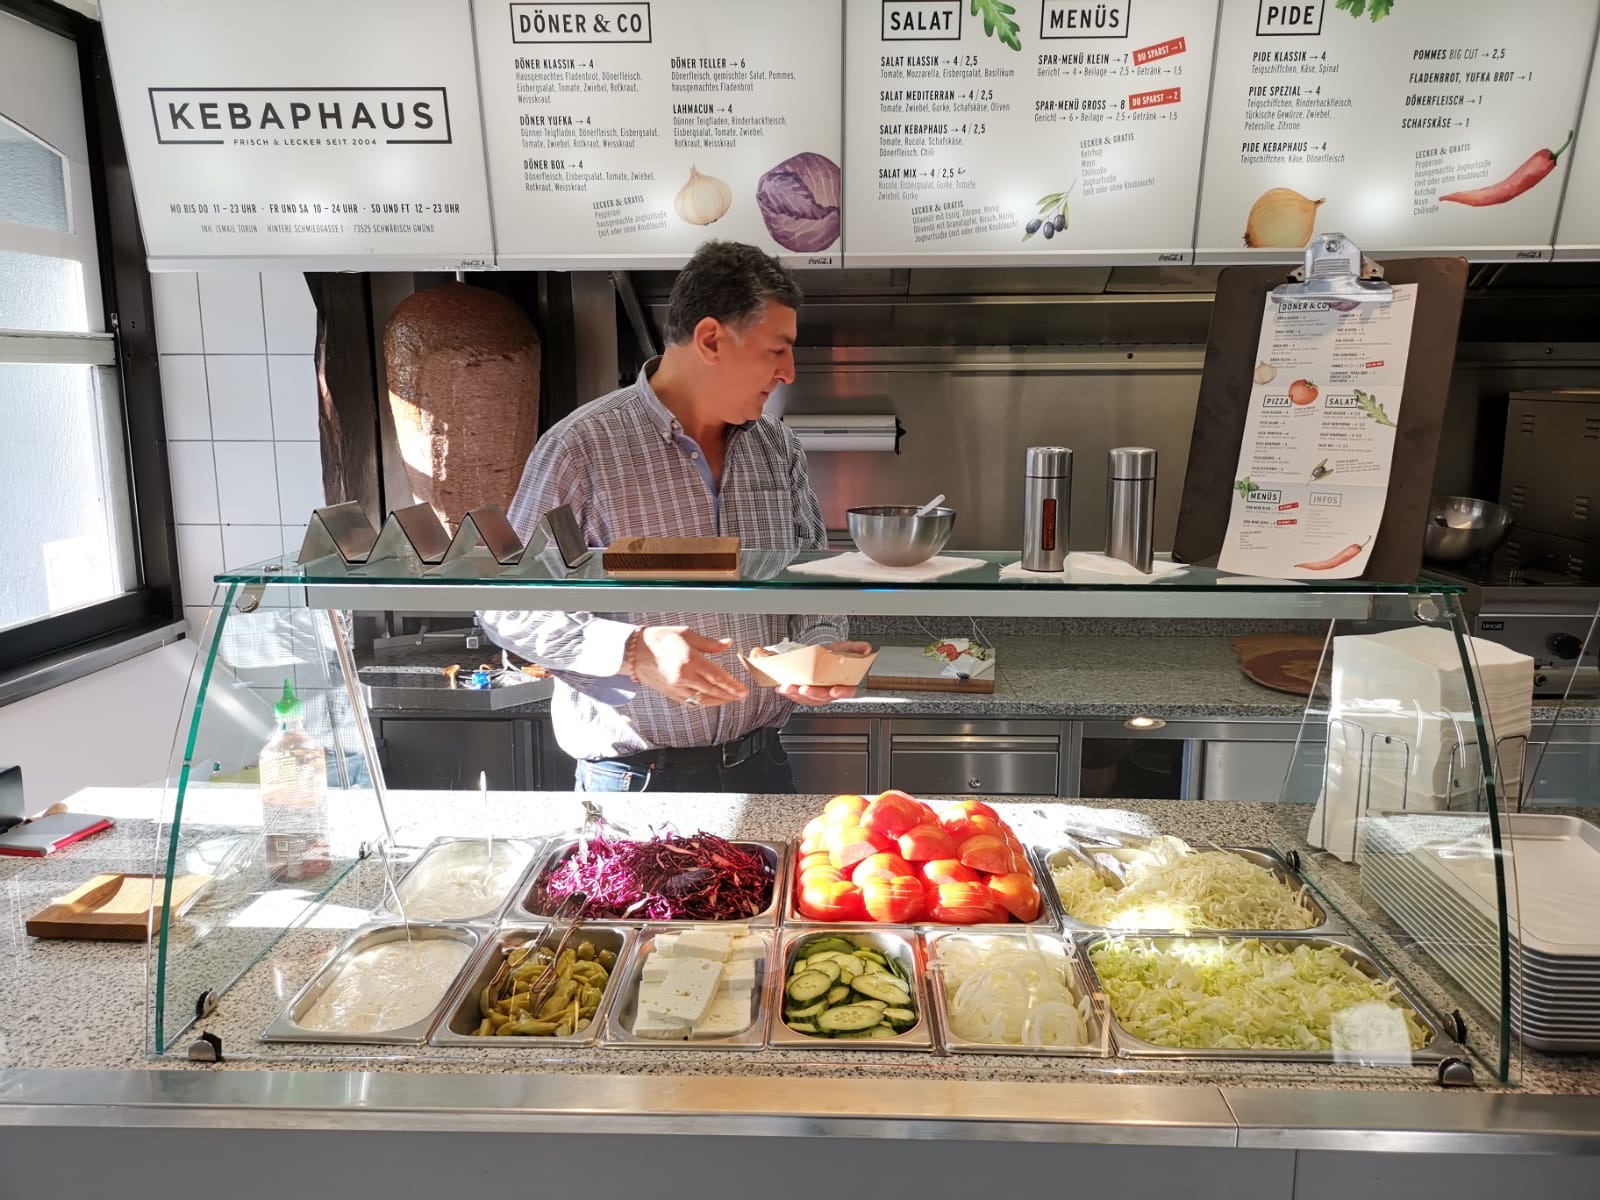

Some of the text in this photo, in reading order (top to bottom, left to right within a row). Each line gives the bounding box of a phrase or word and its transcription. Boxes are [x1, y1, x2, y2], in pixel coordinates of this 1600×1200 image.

[890, 11, 952, 31] SALAT
[1051, 4, 1119, 29] MENÜS
[1268, 5, 1315, 26] PIDE
[520, 10, 642, 33] DÖNER & CO
[1138, 41, 1182, 61] DU SPARST 1
[1253, 52, 1326, 61] PIDE KLASSIK 4
[1413, 49, 1505, 60] POMMES BIG CUT 2,5
[515, 57, 594, 69] DÖNER KLASSIK 4
[671, 56, 745, 68] DÖNER TELLER 6
[881, 57, 904, 66] SALAT
[908, 56, 938, 66] KLASSIK
[1087, 54, 1109, 64] KLEIN
[1124, 54, 1128, 63] 7
[1038, 67, 1059, 76] Gericht
[1084, 67, 1107, 77] Beilage
[1137, 66, 1161, 76] Getränk
[1409, 72, 1532, 83] FLADENBROT, YUFKA BROT 1
[672, 83, 753, 92] hausgemachtes Fladenbrot
[1249, 86, 1320, 96] PIDE SPEZIAL 4
[518, 95, 550, 103] Weisskraut
[880, 91, 903, 100] SALAT
[906, 91, 954, 100] MEDITERRAN
[1133, 91, 1177, 105] DU SPARST 2
[1406, 94, 1482, 106] DÖNERFLEISCH 1
[673, 104, 732, 114] LAHMACUN 4
[1082, 100, 1106, 110] GROSS
[1121, 100, 1125, 109] 8
[168, 102, 434, 129] KEBAPHAUS
[520, 114, 591, 126] DÖNER YUFKA 4
[1402, 117, 1469, 128] SCHAFSKÄSE 1
[880, 125, 902, 134] SALAT
[905, 125, 948, 134] KEBAPHAUS
[1242, 142, 1326, 152] PIDE KEBAPHAUS 4
[1416, 149, 1437, 158] LECKER
[1449, 144, 1470, 154] GRATIS
[524, 158, 583, 169] DÖNER BOX 4
[880, 169, 901, 178] SALAT
[904, 169, 916, 178] MIX
[171, 203, 460, 213] MO BIS DO 11 23 UHR FR UND SA 10 24 UHR SO UND FT 12 23 UHR
[1251, 492, 1277, 500] MENÜS
[1313, 496, 1337, 504] INFOS
